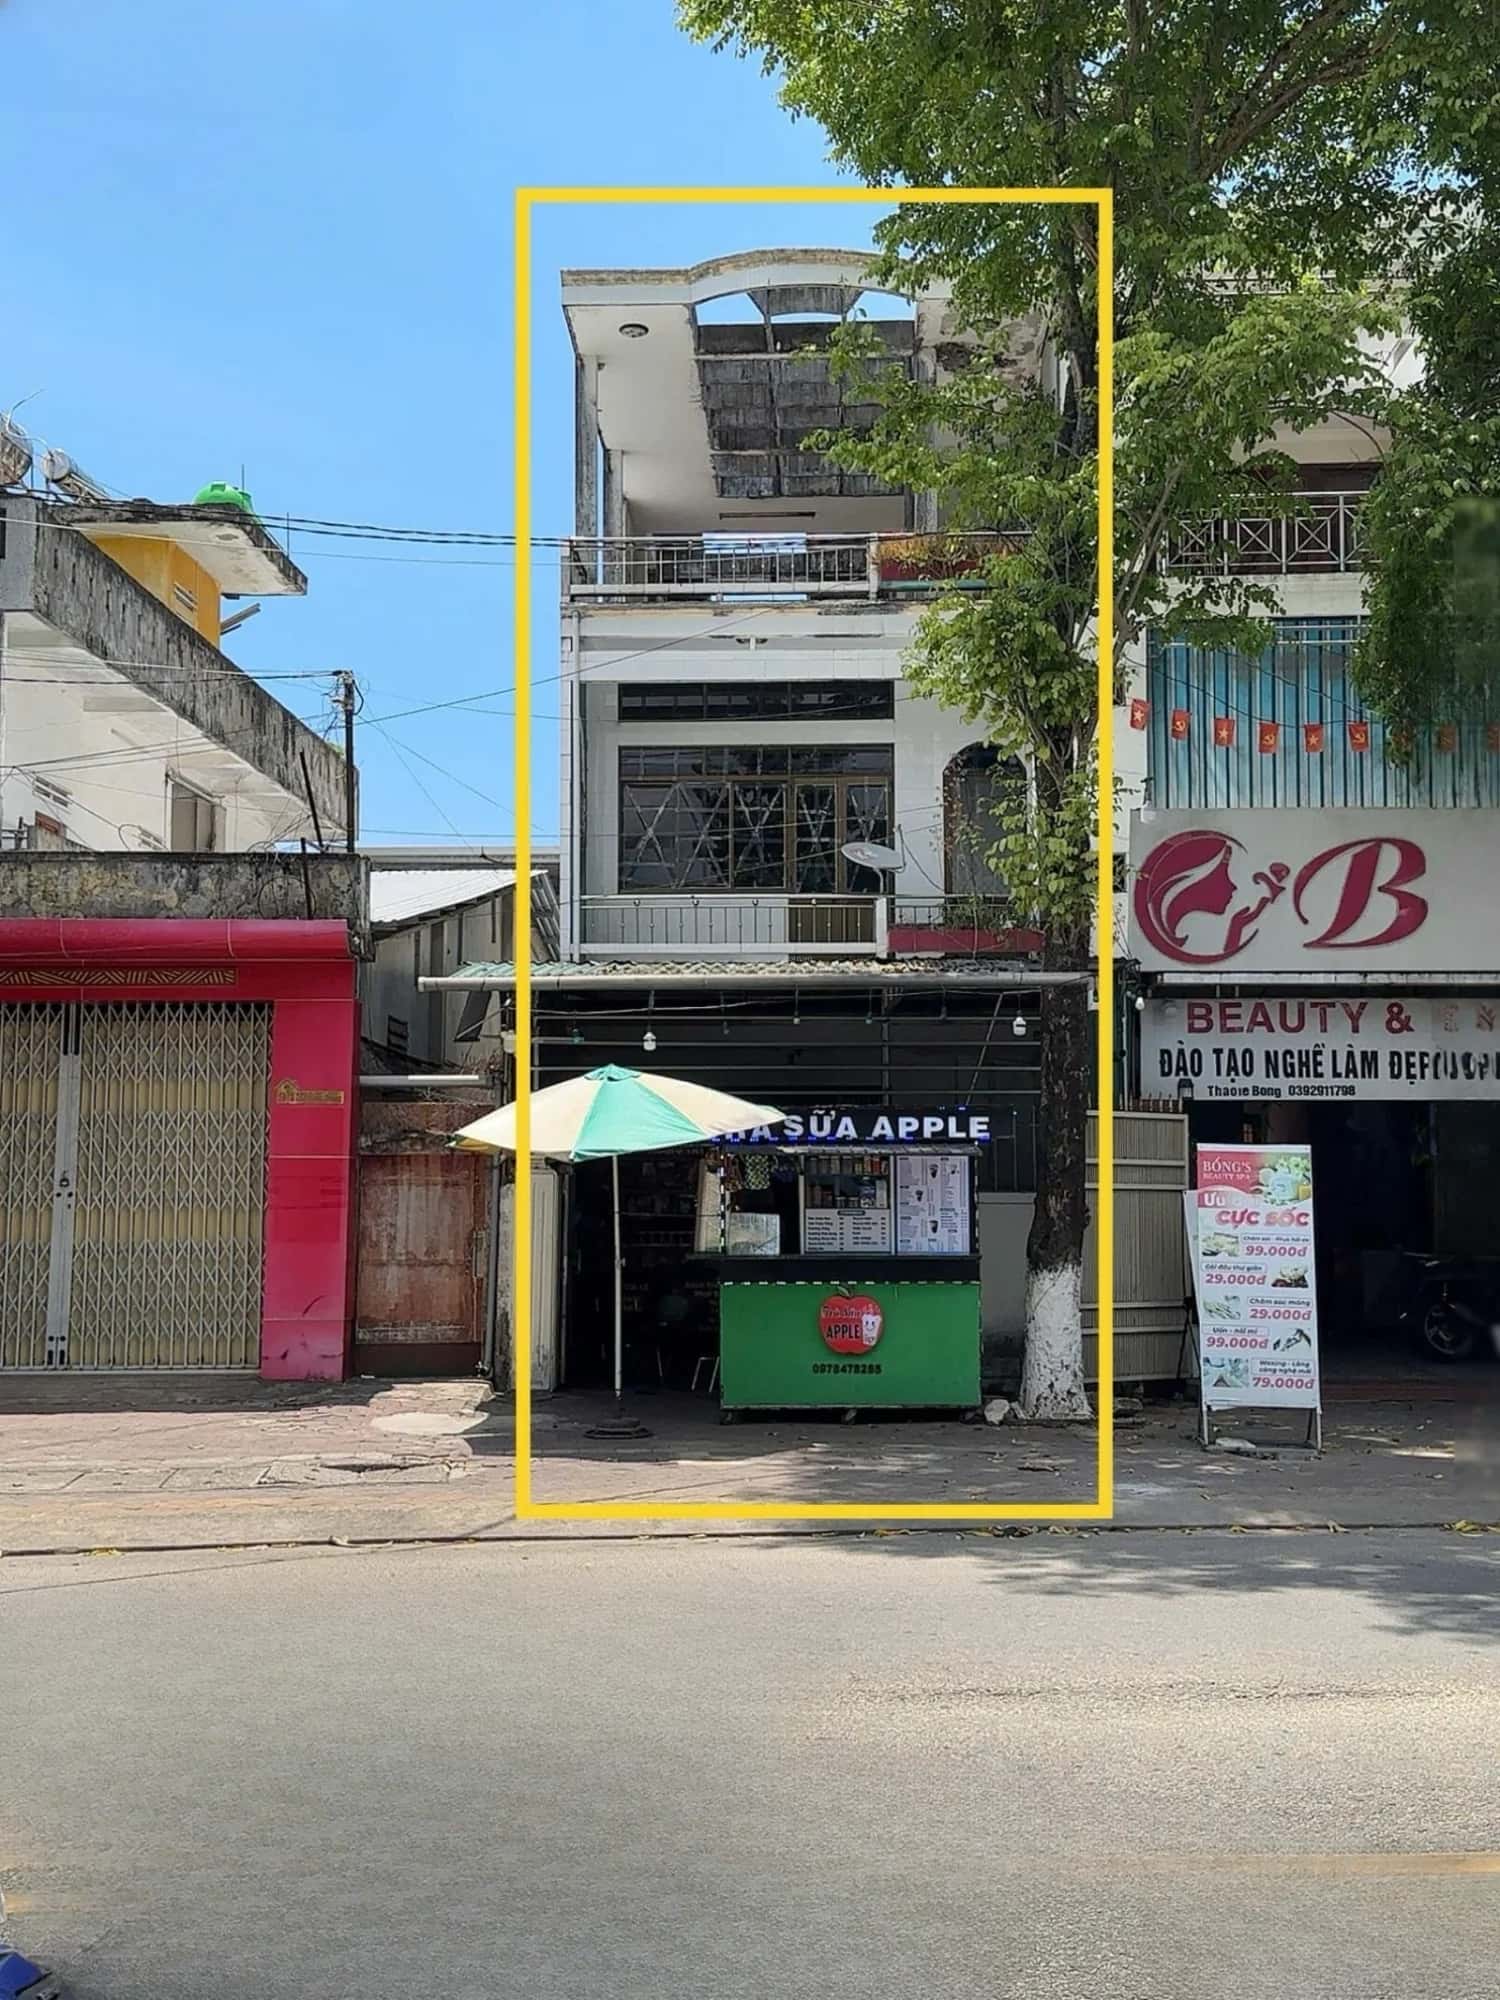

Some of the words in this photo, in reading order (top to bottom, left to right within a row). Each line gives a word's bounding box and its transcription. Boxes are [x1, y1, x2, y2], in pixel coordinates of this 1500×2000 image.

[1186, 1001, 1369, 1034] BEAUTY
[1385, 1001, 1415, 1034] &
[1159, 1040, 1203, 1078] ĐÀO
[1213, 1048, 1254, 1083] TẠO
[1265, 1042, 1326, 1079] NGHỀ
[1331, 1044, 1379, 1080] LÀM
[783, 1109, 858, 1139] SỮA
[872, 1115, 991, 1139] APPLE
[826, 1324, 861, 1339] APPLE
